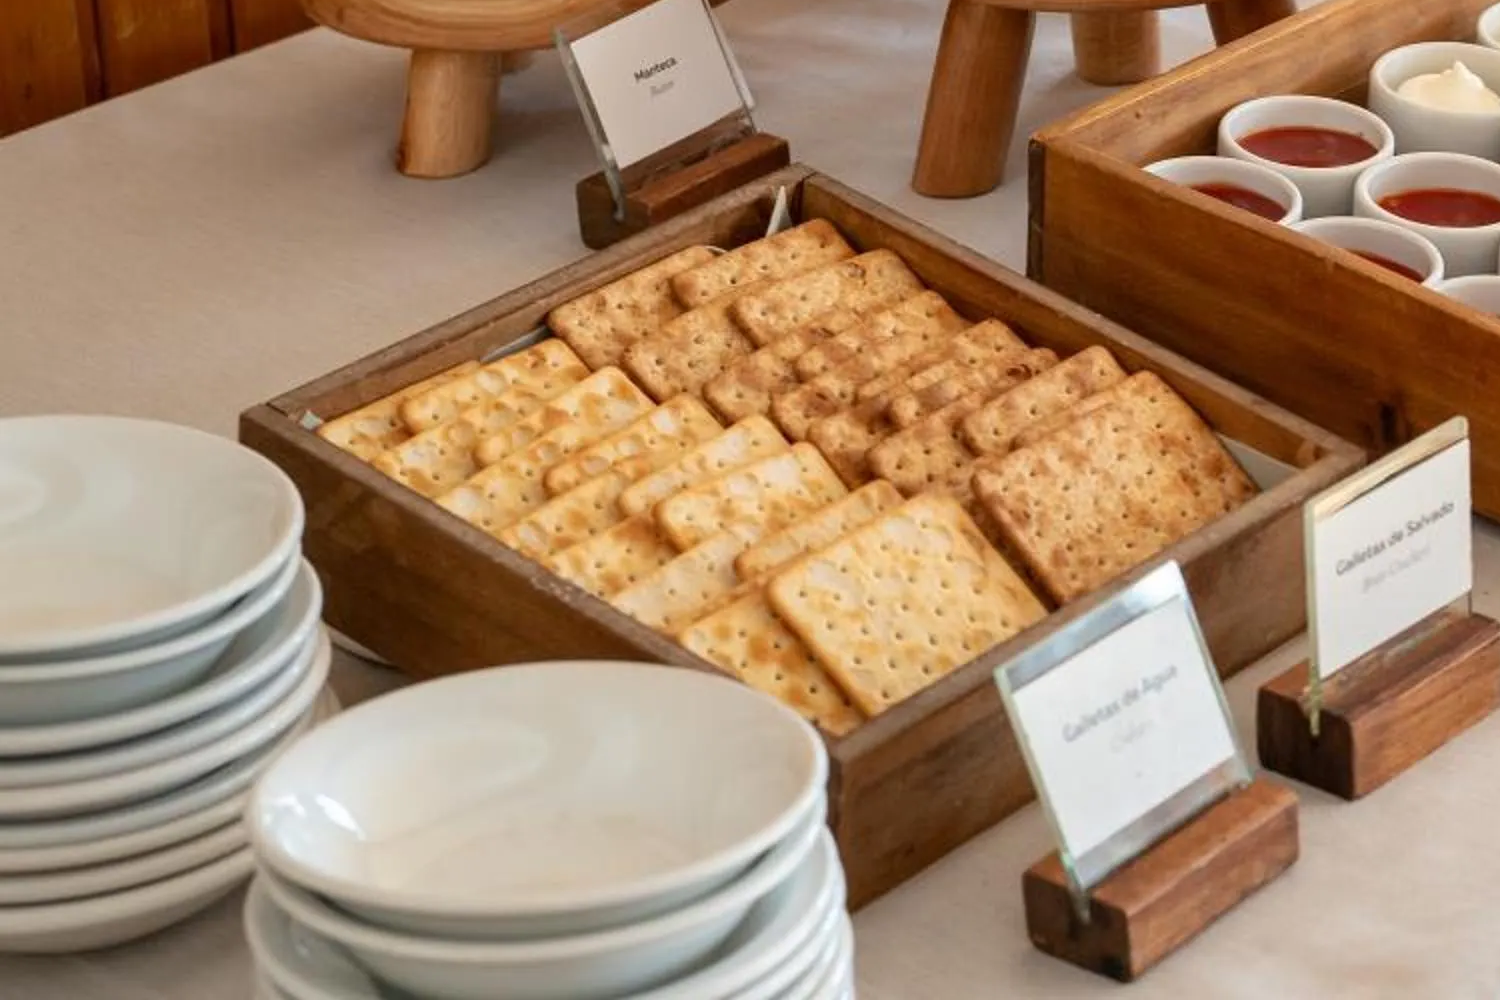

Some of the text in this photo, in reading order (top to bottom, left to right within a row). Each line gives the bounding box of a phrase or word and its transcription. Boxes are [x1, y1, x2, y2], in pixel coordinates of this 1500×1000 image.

[633, 56, 678, 84] Manteca
[1335, 540, 1387, 577] Galletas
[1386, 529, 1404, 548] de
[1406, 501, 1455, 537] Salvado
[1061, 699, 1121, 744] Galletas
[1121, 688, 1141, 708] de
[1141, 663, 1178, 696] Agua
